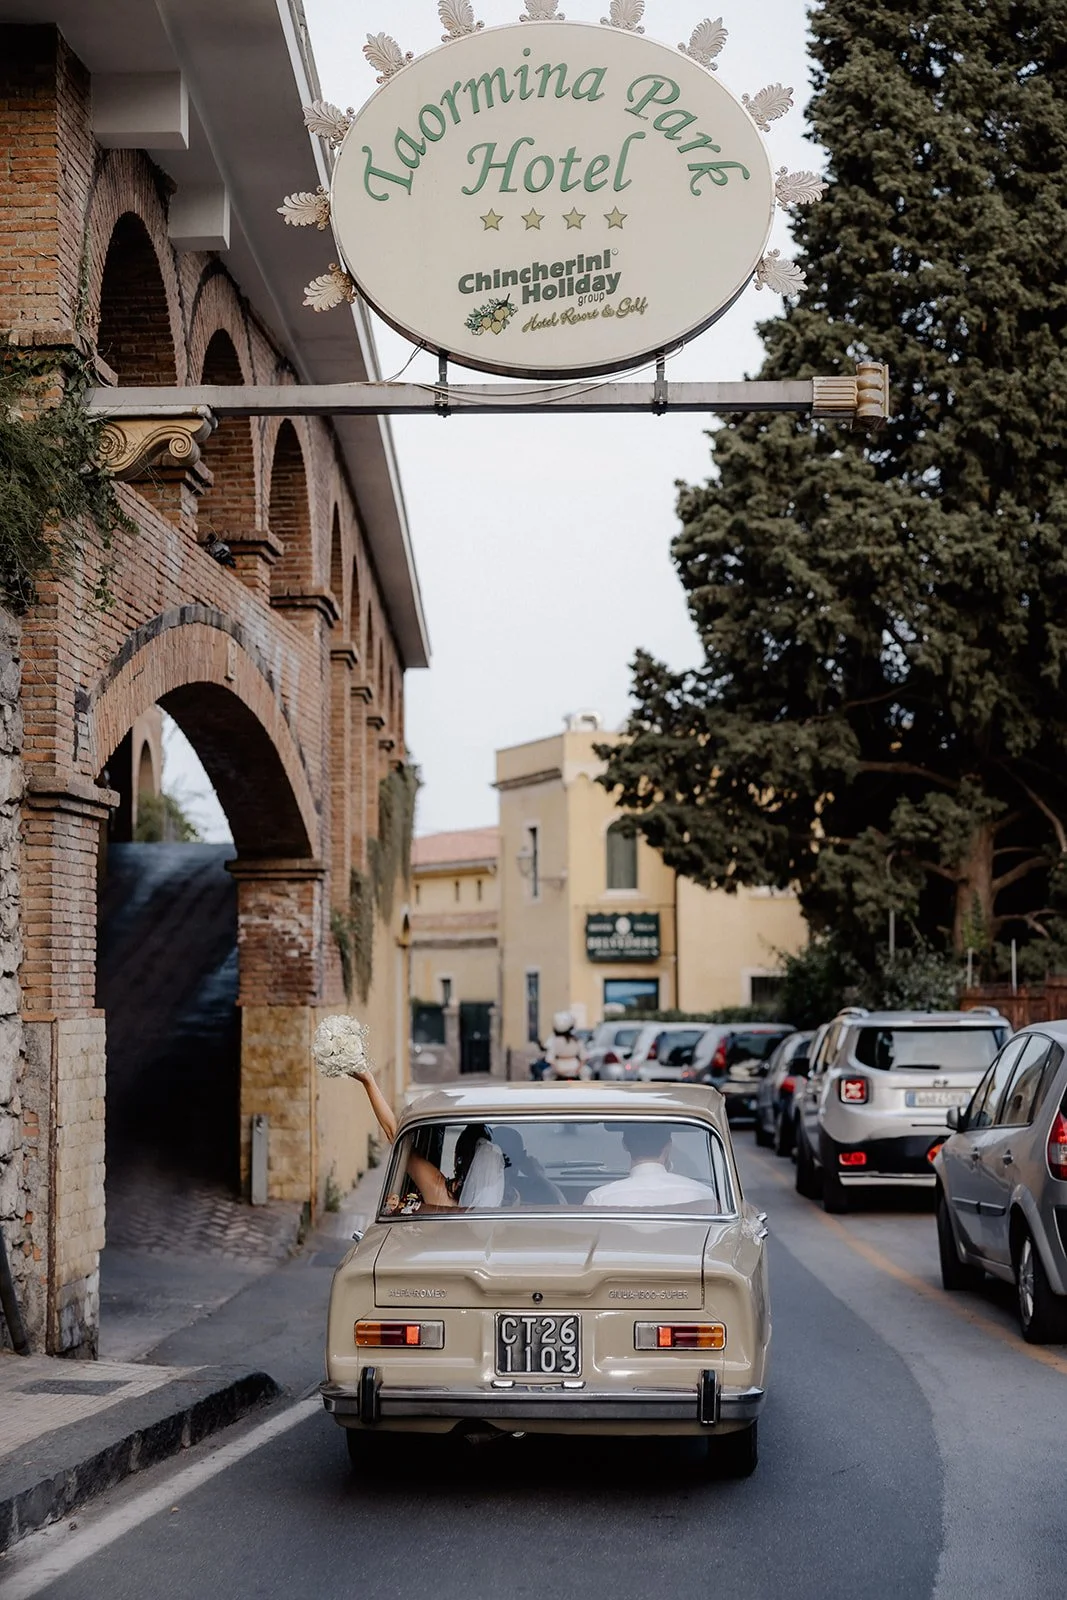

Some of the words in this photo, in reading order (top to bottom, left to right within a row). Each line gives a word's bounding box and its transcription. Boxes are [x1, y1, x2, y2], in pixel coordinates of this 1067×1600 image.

[361, 47, 609, 201] Taormina
[623, 73, 751, 197] Park
[461, 131, 646, 196] Hotel
[522, 271, 622, 305] Holiday
[577, 291, 605, 307] group
[615, 296, 649, 319] Golf
[505, 1345, 577, 1373] 1103
